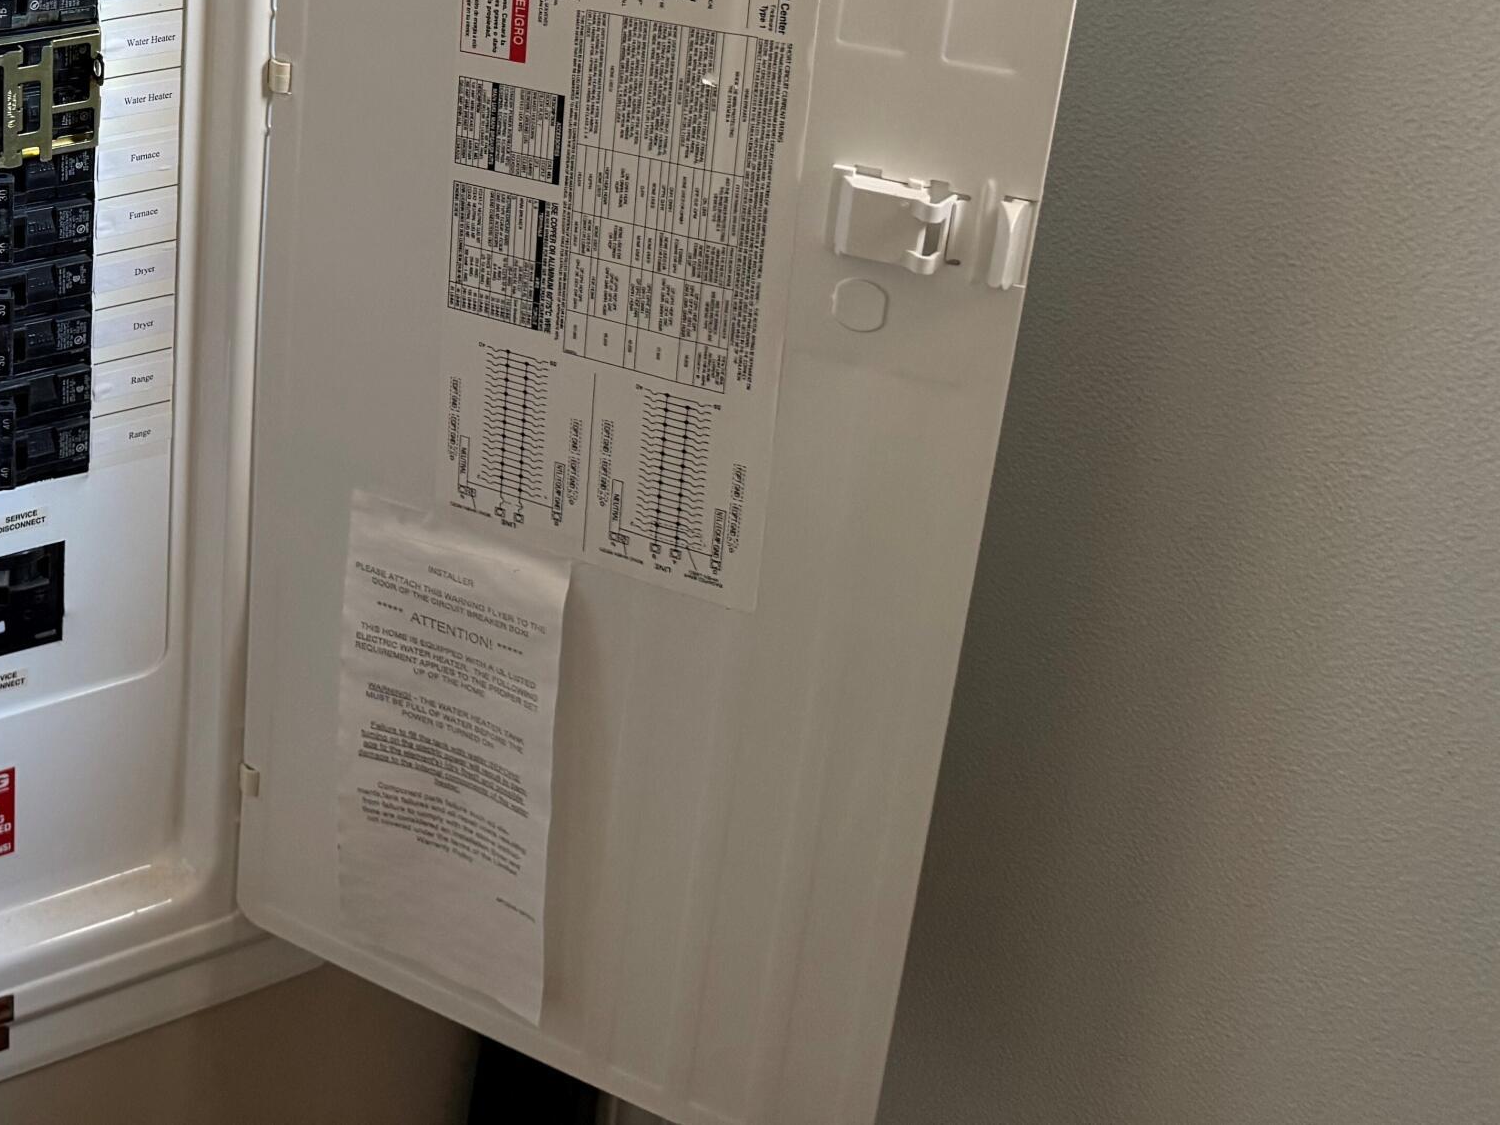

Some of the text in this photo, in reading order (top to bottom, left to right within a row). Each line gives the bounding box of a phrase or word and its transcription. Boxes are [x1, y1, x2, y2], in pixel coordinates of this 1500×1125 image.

[759, 5, 769, 23] Type
[778, 2, 790, 35] Center
[126, 33, 176, 47] Water Heater
[124, 91, 173, 106] Water Heater
[130, 150, 160, 163] Furnace
[128, 207, 158, 220] Furnace
[134, 265, 155, 277] Dryer
[133, 320, 154, 331] Dryer
[131, 374, 154, 386] Range
[128, 428, 152, 441] Range
[5, 509, 38, 523] SERVICE
[427, 564, 475, 588] INSTALLER
[410, 612, 493, 650] ATTENTION!
